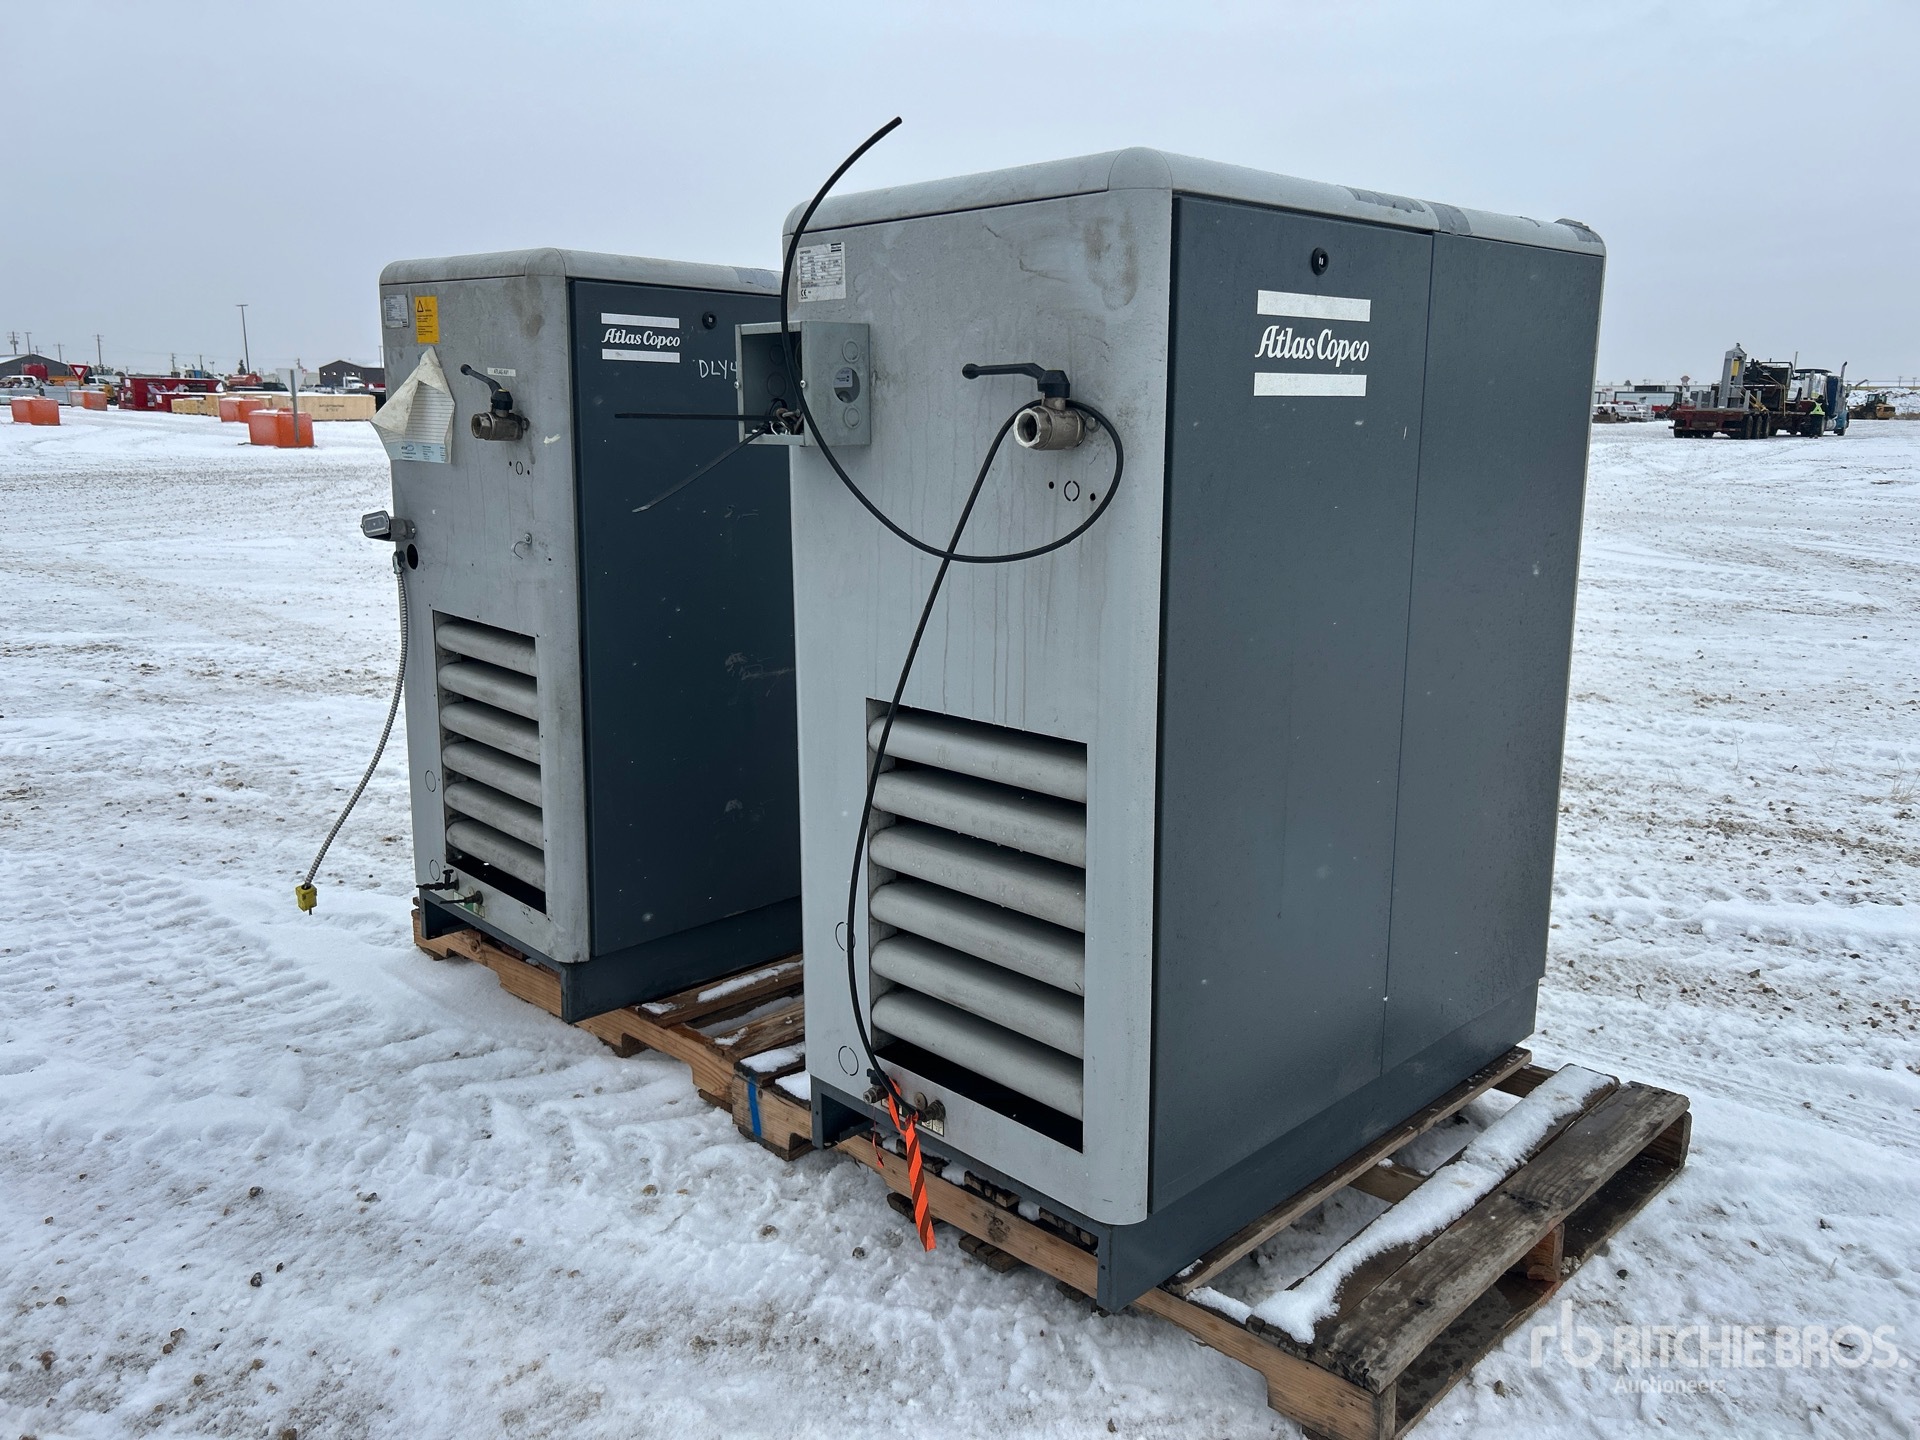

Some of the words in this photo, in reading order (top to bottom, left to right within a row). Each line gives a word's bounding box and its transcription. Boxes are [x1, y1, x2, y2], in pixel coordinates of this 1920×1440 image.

[601, 328, 642, 345] Atlas
[642, 330, 680, 349] Copco
[1254, 325, 1316, 360] Atlas
[1317, 328, 1370, 368] Copco
